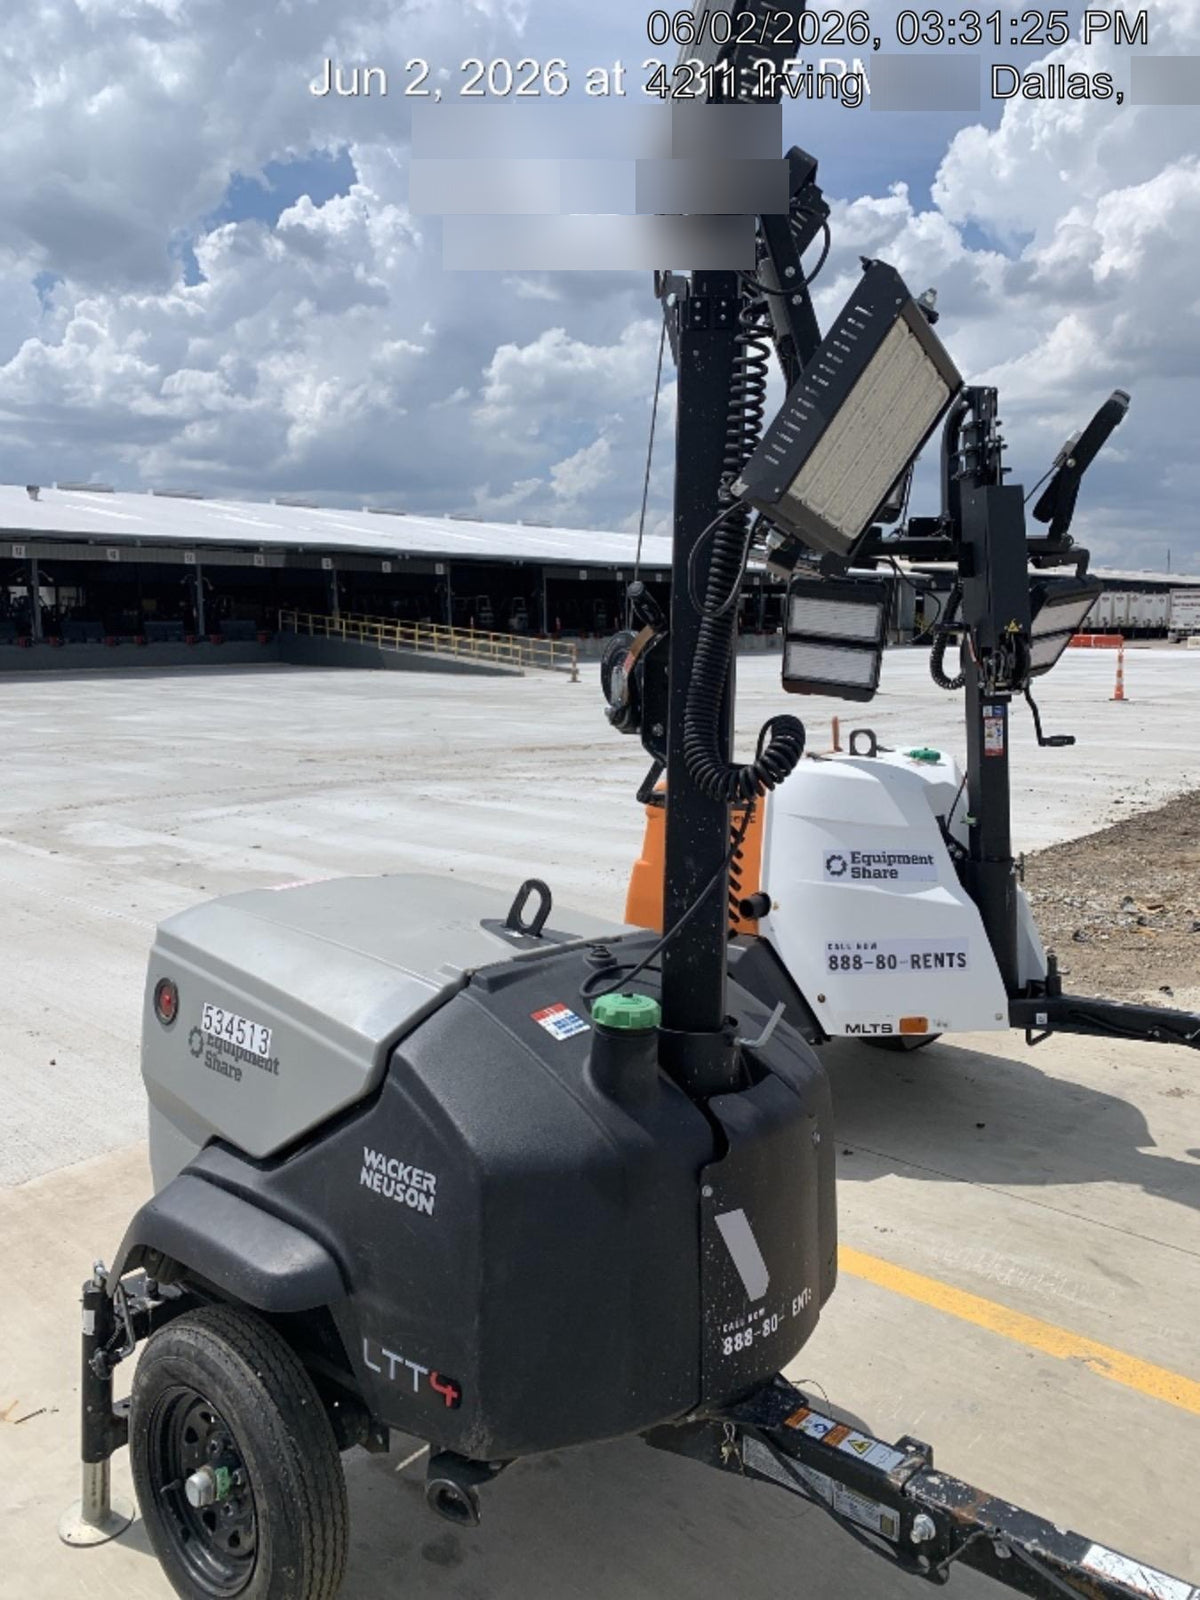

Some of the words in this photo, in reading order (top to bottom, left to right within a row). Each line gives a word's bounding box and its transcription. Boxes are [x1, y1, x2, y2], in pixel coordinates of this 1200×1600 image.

[850, 851, 935, 866] Equipment
[851, 867, 899, 879] Share
[204, 1005, 270, 1056] 534513
[845, 1024, 893, 1034] MLTS
[204, 1050, 242, 1082] Share
[360, 1165, 435, 1217] NEUSON
[363, 1146, 437, 1196] WACKER
[363, 1338, 458, 1408] LTT4
